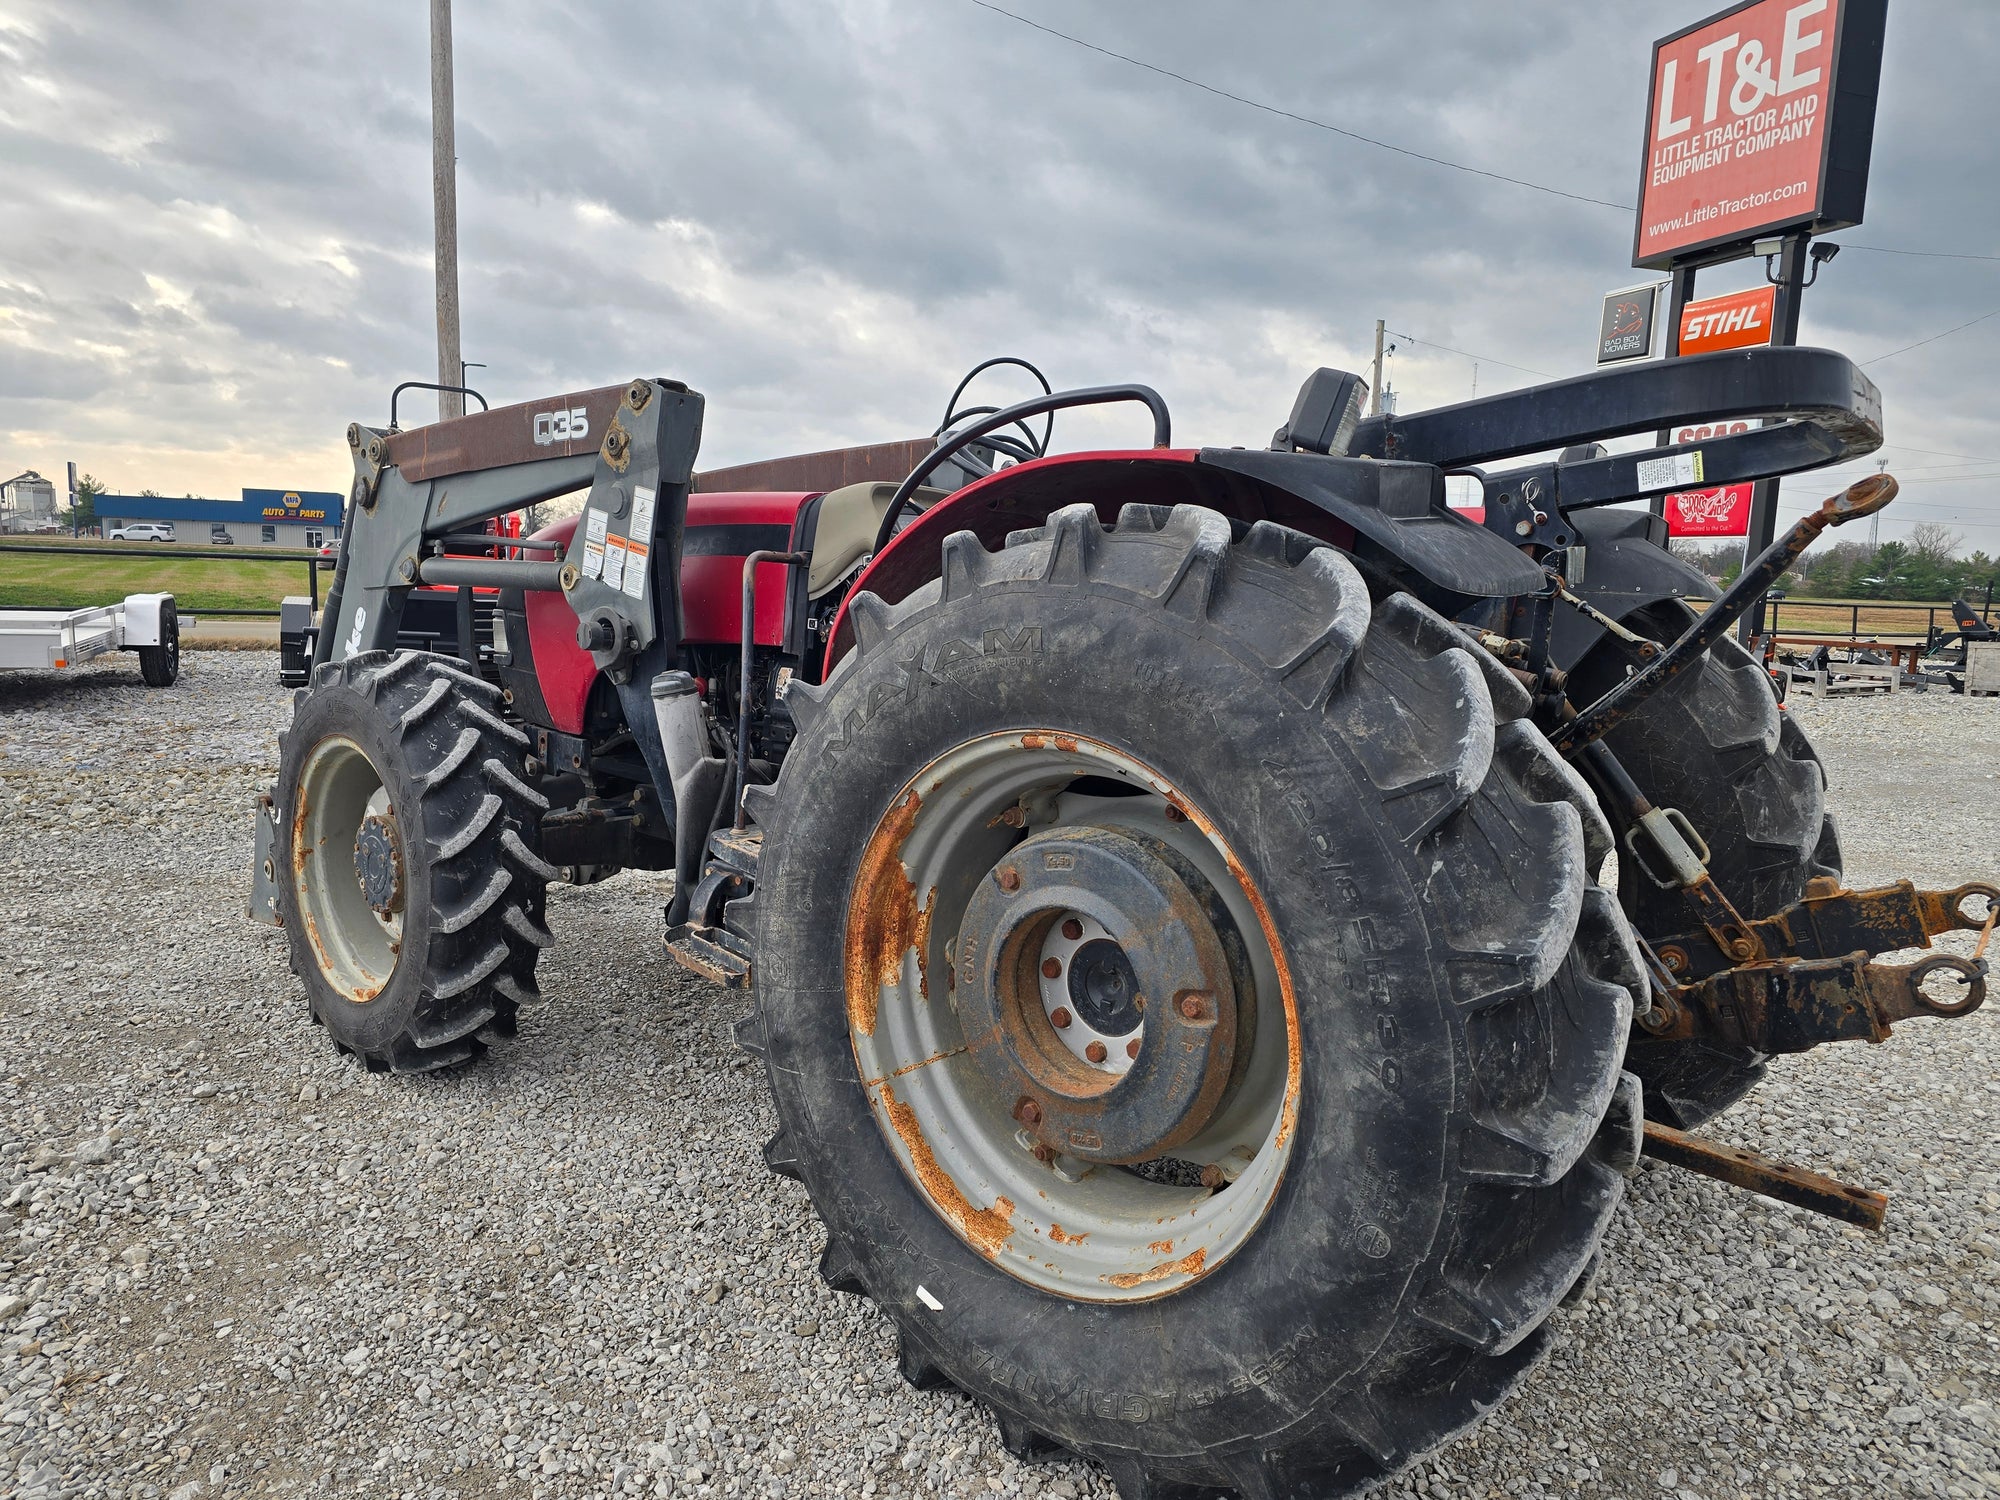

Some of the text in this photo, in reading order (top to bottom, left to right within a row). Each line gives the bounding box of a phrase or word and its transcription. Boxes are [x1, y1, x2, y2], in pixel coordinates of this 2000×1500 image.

[1657, 0, 1828, 141] LT&E
[1654, 94, 1818, 169] LITTLE TRACTOR AND
[1652, 116, 1815, 187] EQUIPMENT COMPANY
[1649, 180, 1808, 237] www.LittleTractor.com
[1604, 334, 1641, 347] BAD BOY
[1684, 304, 1762, 341] STIHL
[1604, 340, 1641, 354] MOWERS
[533, 406, 589, 446] Q35
[262, 507, 285, 516] AUTO
[300, 509, 325, 518] PARTS
[286, 496, 299, 504] NAPA
